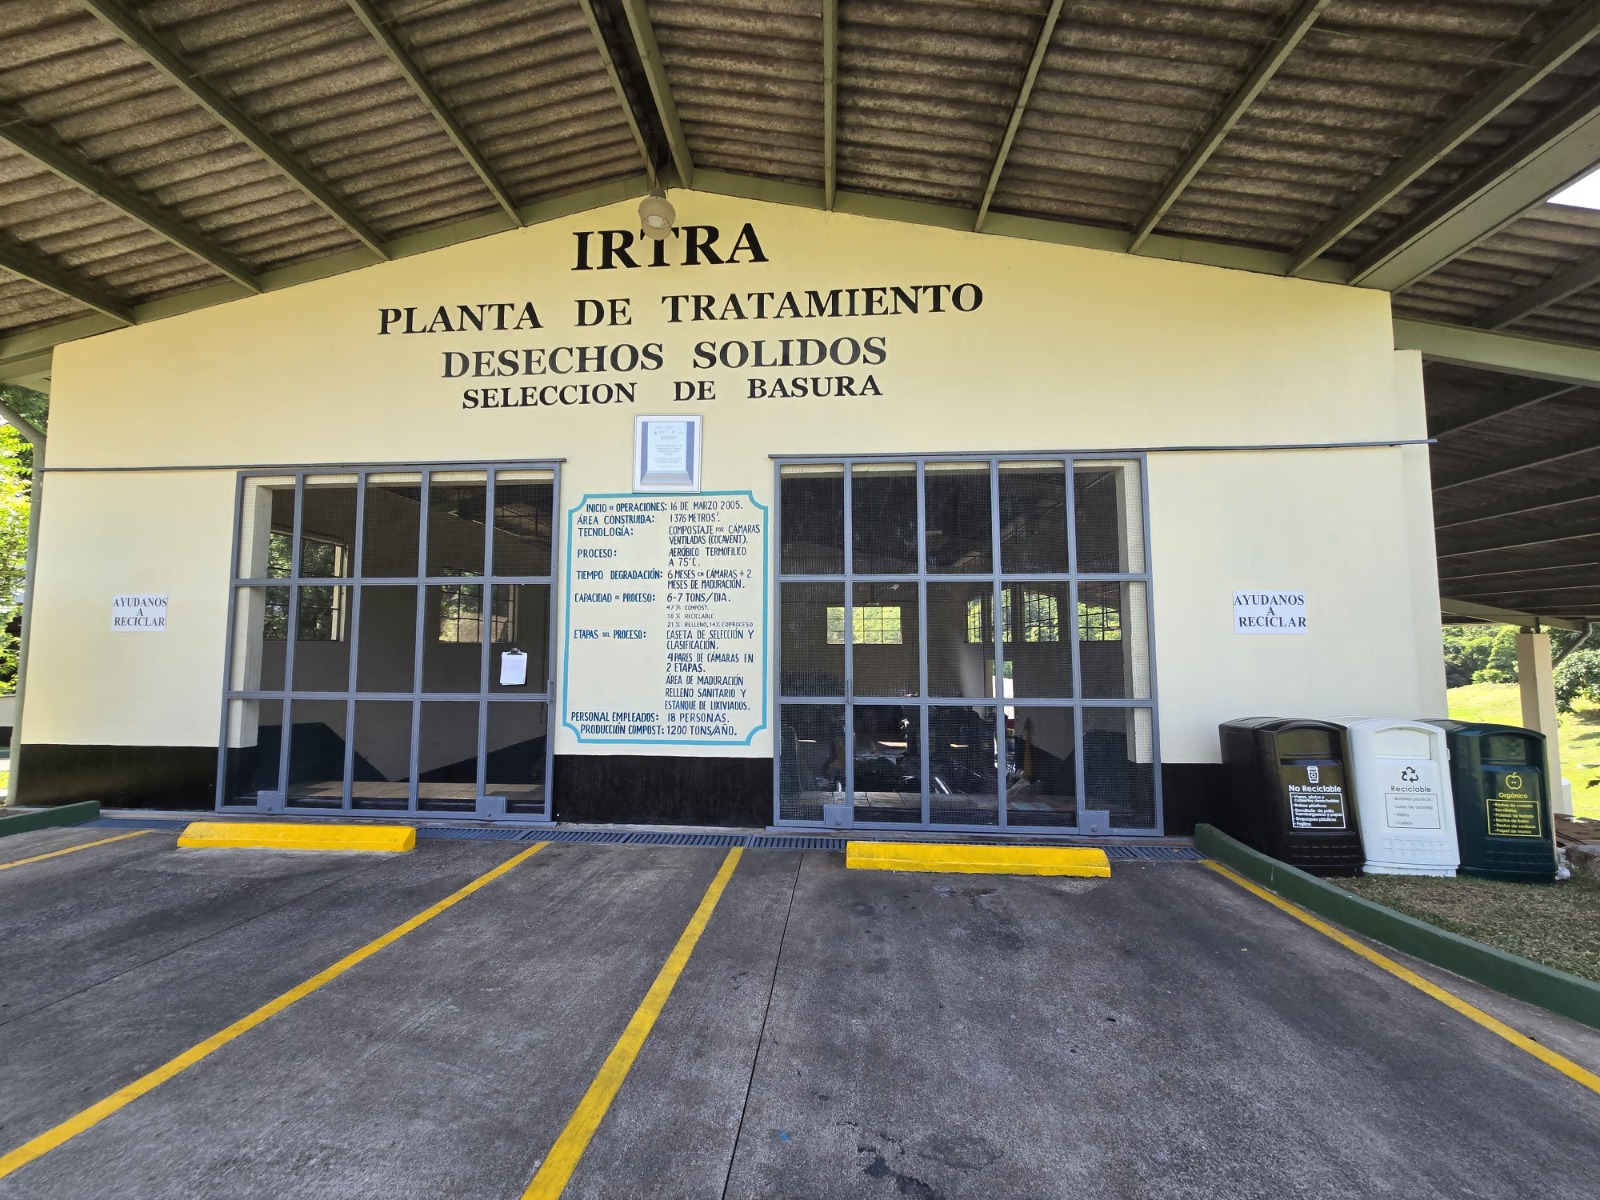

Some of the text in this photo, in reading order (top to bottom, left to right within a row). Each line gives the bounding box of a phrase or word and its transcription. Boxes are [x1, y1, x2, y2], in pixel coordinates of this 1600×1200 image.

[571, 222, 769, 270] IRTRA
[377, 283, 983, 335] PLANTA DE TRATAMIENTO
[441, 336, 887, 378] DESECHOS SOLIDOS
[462, 374, 883, 410] SELECCION DE BASURA
[586, 504, 607, 512] INICIO
[616, 502, 667, 512] OPERACIONES:
[670, 502, 678, 510] 16
[680, 502, 688, 510] DE
[693, 501, 717, 510] MARZO
[720, 500, 743, 510] 2005.
[577, 514, 598, 525] ÁREA
[604, 514, 655, 525] CONSTRUIDA:
[578, 525, 633, 537] TECNOLOGÍA:
[668, 525, 713, 535] COMPOSTAJE
[728, 523, 760, 534] CÁMARAS
[668, 535, 706, 545] VENTILADAS
[578, 546, 746, 558] PROCESO: AERÓBICO TERMOFILICO
[668, 558, 674, 566] A
[576, 570, 603, 580] TIEMPO
[610, 568, 663, 580] DEGRADACIÓN:
[667, 570, 673, 579] 6
[675, 570, 695, 579] MESES
[706, 568, 738, 579] CÁMARAS
[746, 569, 752, 578] 2
[668, 580, 688, 590] MESES
[691, 580, 698, 589] DE
[113, 598, 168, 607] AYUDANOS
[574, 593, 612, 602] CAPACIDAD
[623, 593, 655, 602] PROCESO:
[666, 593, 683, 602] 6-7
[686, 592, 731, 603] TONS/DIA.
[1233, 594, 1304, 605] AYUDANOS
[137, 608, 144, 616] A
[1266, 606, 1275, 616] A
[114, 617, 165, 626] RECICLAR
[1239, 616, 1306, 627] RECICLAR
[574, 630, 598, 639] ETAPAS
[614, 630, 646, 639] PROCESO:
[666, 630, 693, 639] CASETA
[697, 630, 705, 639] DE
[709, 628, 744, 639] SELECCIÓN
[748, 630, 754, 639] Y
[697, 653, 703, 662] DE
[707, 651, 739, 663] CÁMARAS
[744, 654, 754, 663] EN
[666, 663, 706, 672] 2 ETAPAS.
[666, 673, 743, 686] ÁREA DE MADURACIÓN
[665, 688, 746, 698] RELLENO SANITARIO Y
[665, 700, 750, 710] ESTANQUE DE LIXIVIADOS.
[571, 712, 729, 722] PERSONAL EMPLEADOS: 18 PERSONAS.
[581, 722, 625, 734] PRODUCCIÓN
[628, 725, 664, 735] COMPOST:
[667, 725, 687, 735] 1200
